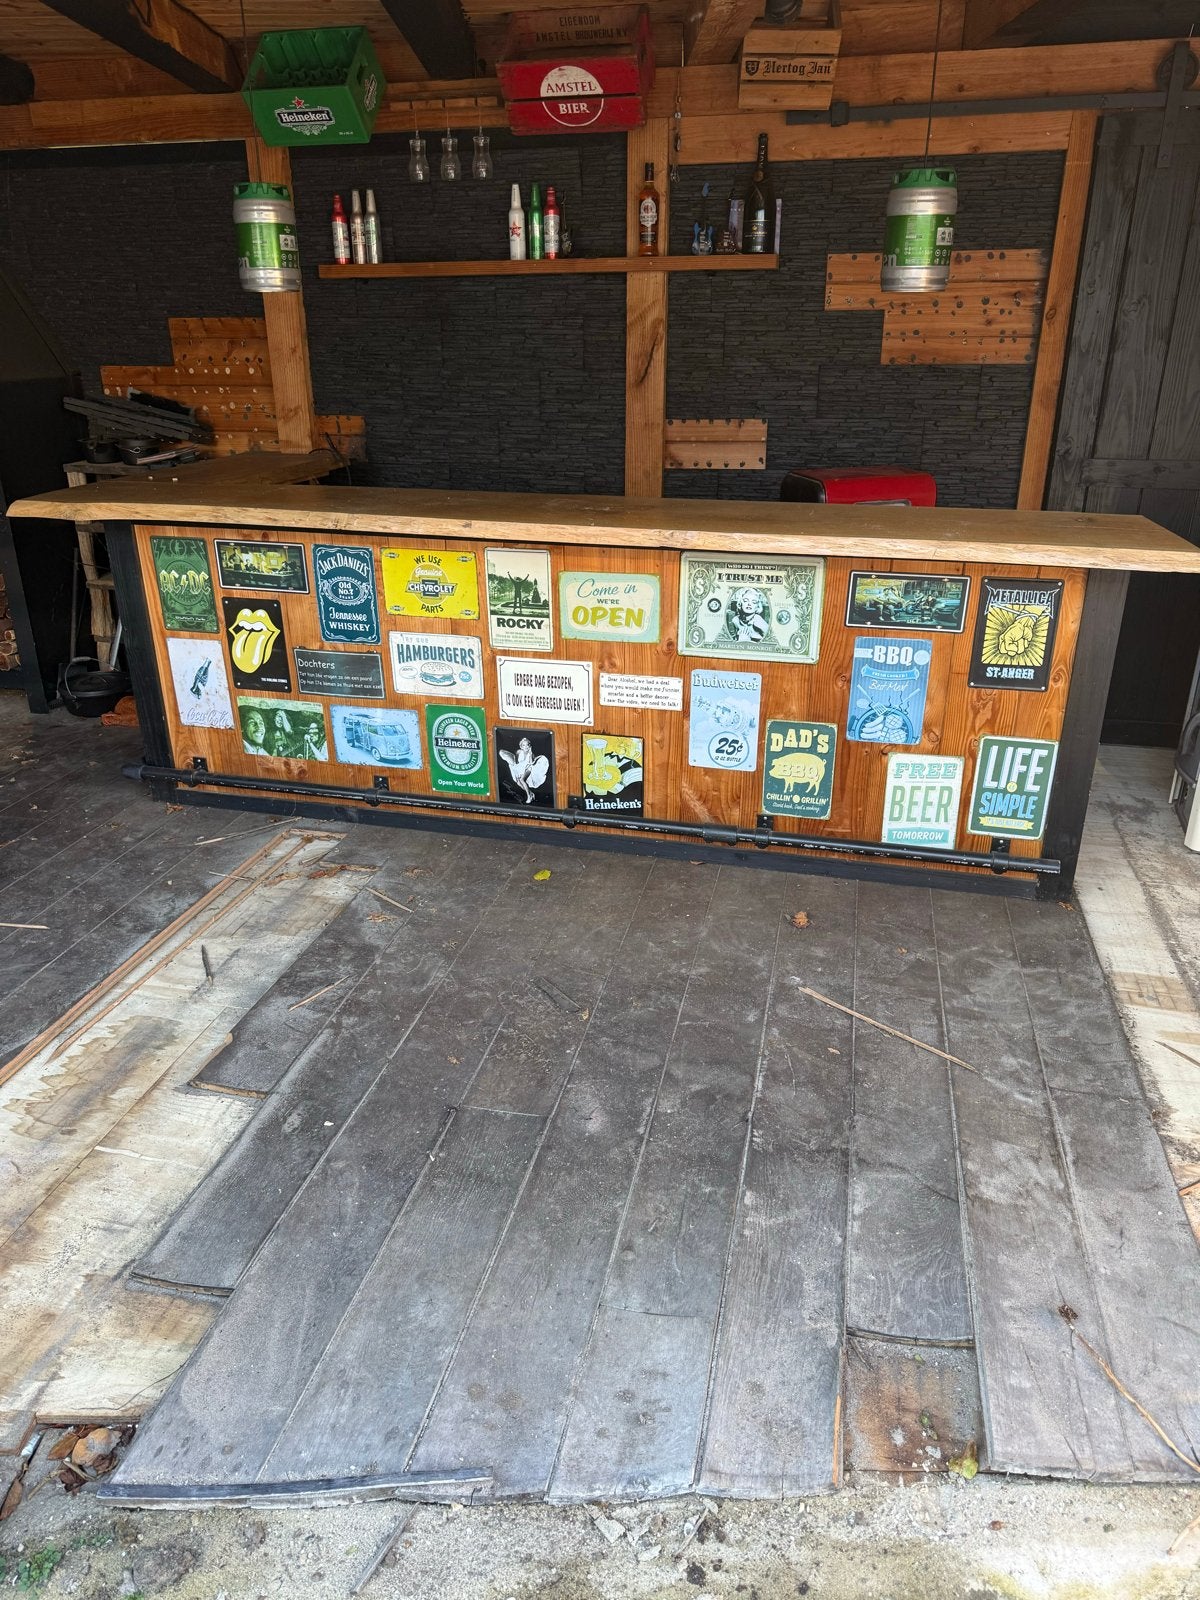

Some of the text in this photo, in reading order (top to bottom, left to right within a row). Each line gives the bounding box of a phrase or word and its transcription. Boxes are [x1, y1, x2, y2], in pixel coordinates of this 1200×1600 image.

[763, 60, 831, 77] Hertog Jan
[546, 81, 597, 94] AMSTEL
[279, 110, 329, 123] Heineken
[558, 102, 591, 115] BIER
[319, 555, 338, 575] JACK
[414, 554, 442, 566] WE USE
[338, 581, 352, 589] Old
[718, 572, 783, 585] I TRUST ME
[409, 583, 453, 593] CHEVROLET
[577, 578, 637, 598] Come in
[985, 586, 1059, 609] METALLICA
[329, 607, 368, 621] Tennessee
[420, 603, 444, 613] PARTS
[572, 605, 644, 628] OPEN
[329, 621, 370, 632] WHISKEY
[496, 617, 544, 629] ROCKY
[298, 658, 335, 669] Dochters
[397, 643, 475, 669] HAMBURGERS
[873, 645, 913, 666] BBQ
[514, 673, 573, 691] IEDERE DAG BEZOPEN,
[693, 674, 759, 691] Budweiser
[506, 693, 511, 706] IS
[512, 693, 523, 707] OOK
[524, 695, 535, 709] EEN
[535, 696, 562, 710] GEREGELD
[563, 698, 581, 711] LEVEN
[438, 738, 477, 749] Heineken
[715, 737, 743, 755] 25¢
[770, 728, 829, 754] DAD'S
[778, 764, 820, 782] BBQ
[893, 762, 958, 780] FREE
[983, 745, 1049, 792] LIFE
[585, 798, 642, 810] Heineken's
[801, 796, 829, 805] GRILLIN'
[888, 785, 953, 823] BEER
[979, 791, 1038, 819] SIMPLE
[892, 830, 944, 841] TOMORROW
